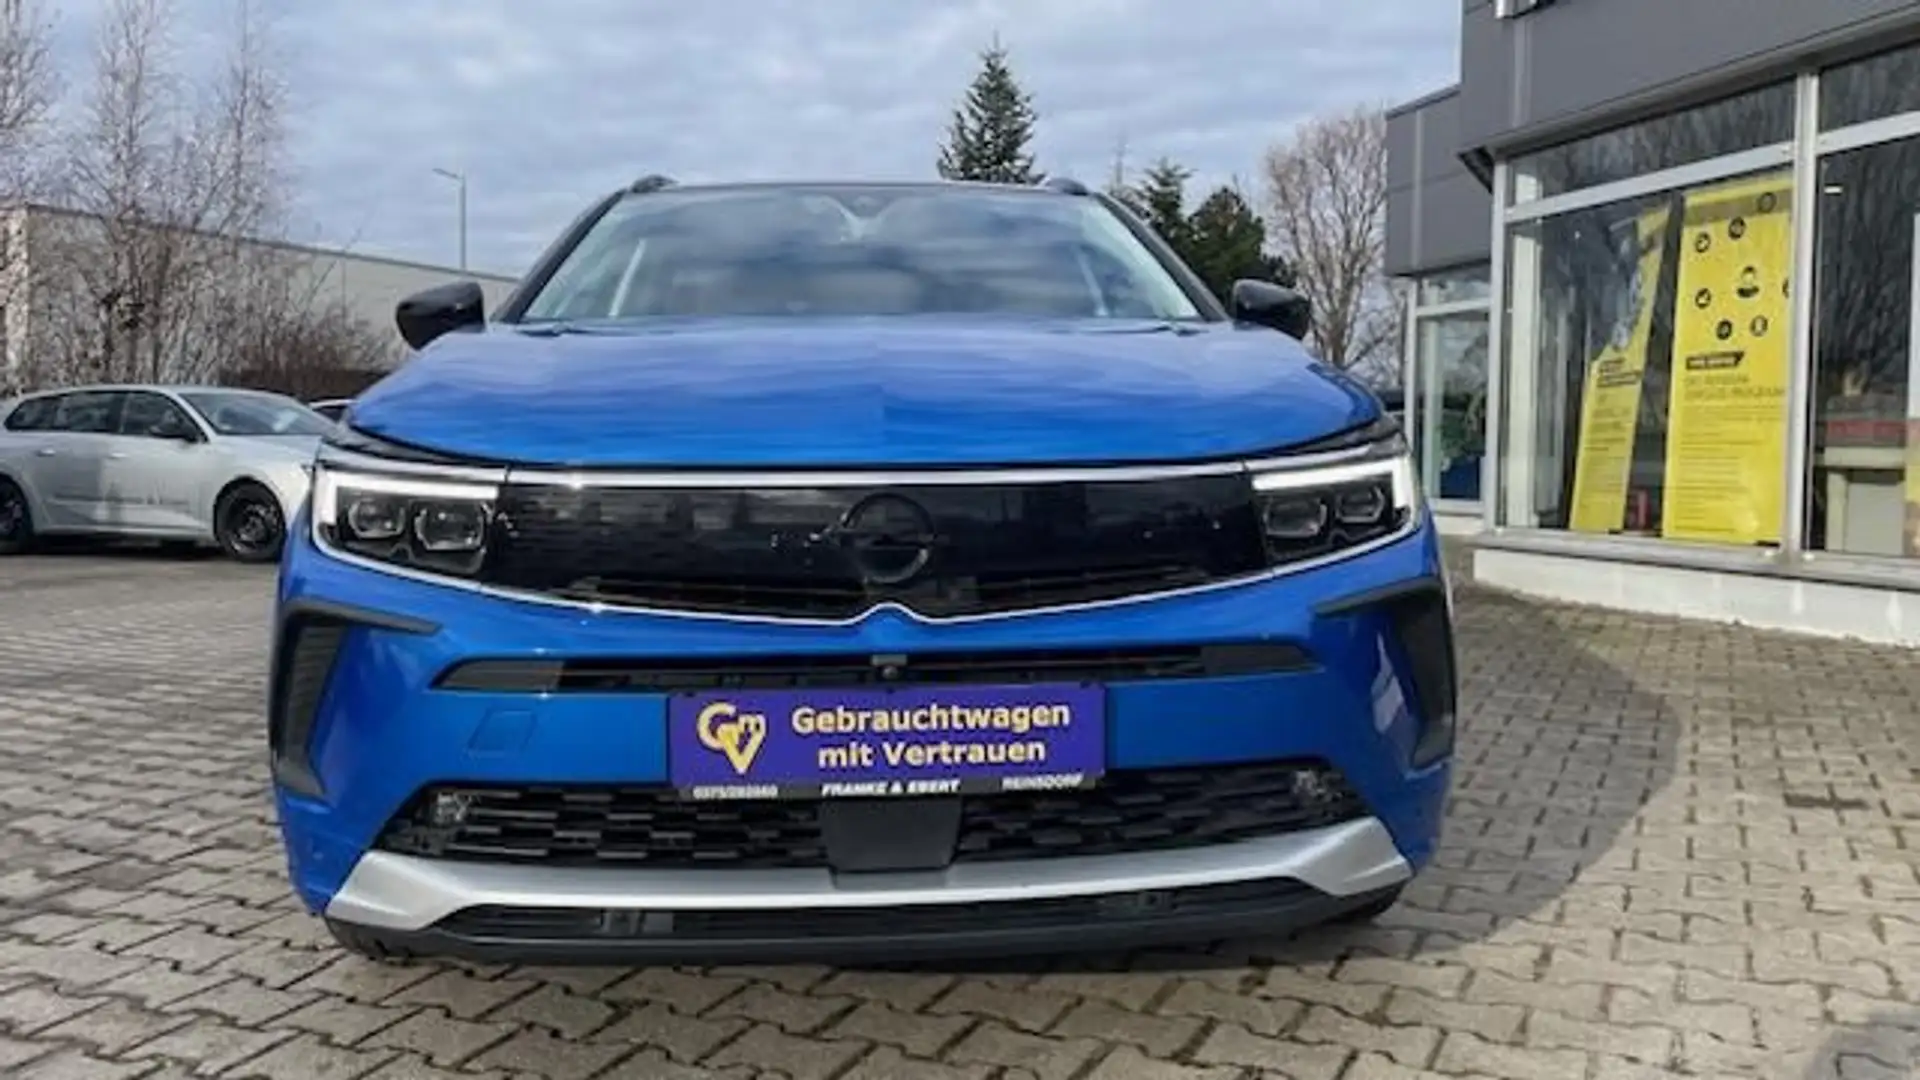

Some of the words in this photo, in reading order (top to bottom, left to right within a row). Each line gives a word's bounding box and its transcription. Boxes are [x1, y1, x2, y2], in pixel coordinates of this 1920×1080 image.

[792, 702, 1071, 736] Gebrauchtwagen
[818, 742, 874, 769] mit
[883, 738, 1047, 767] Vertrauen
